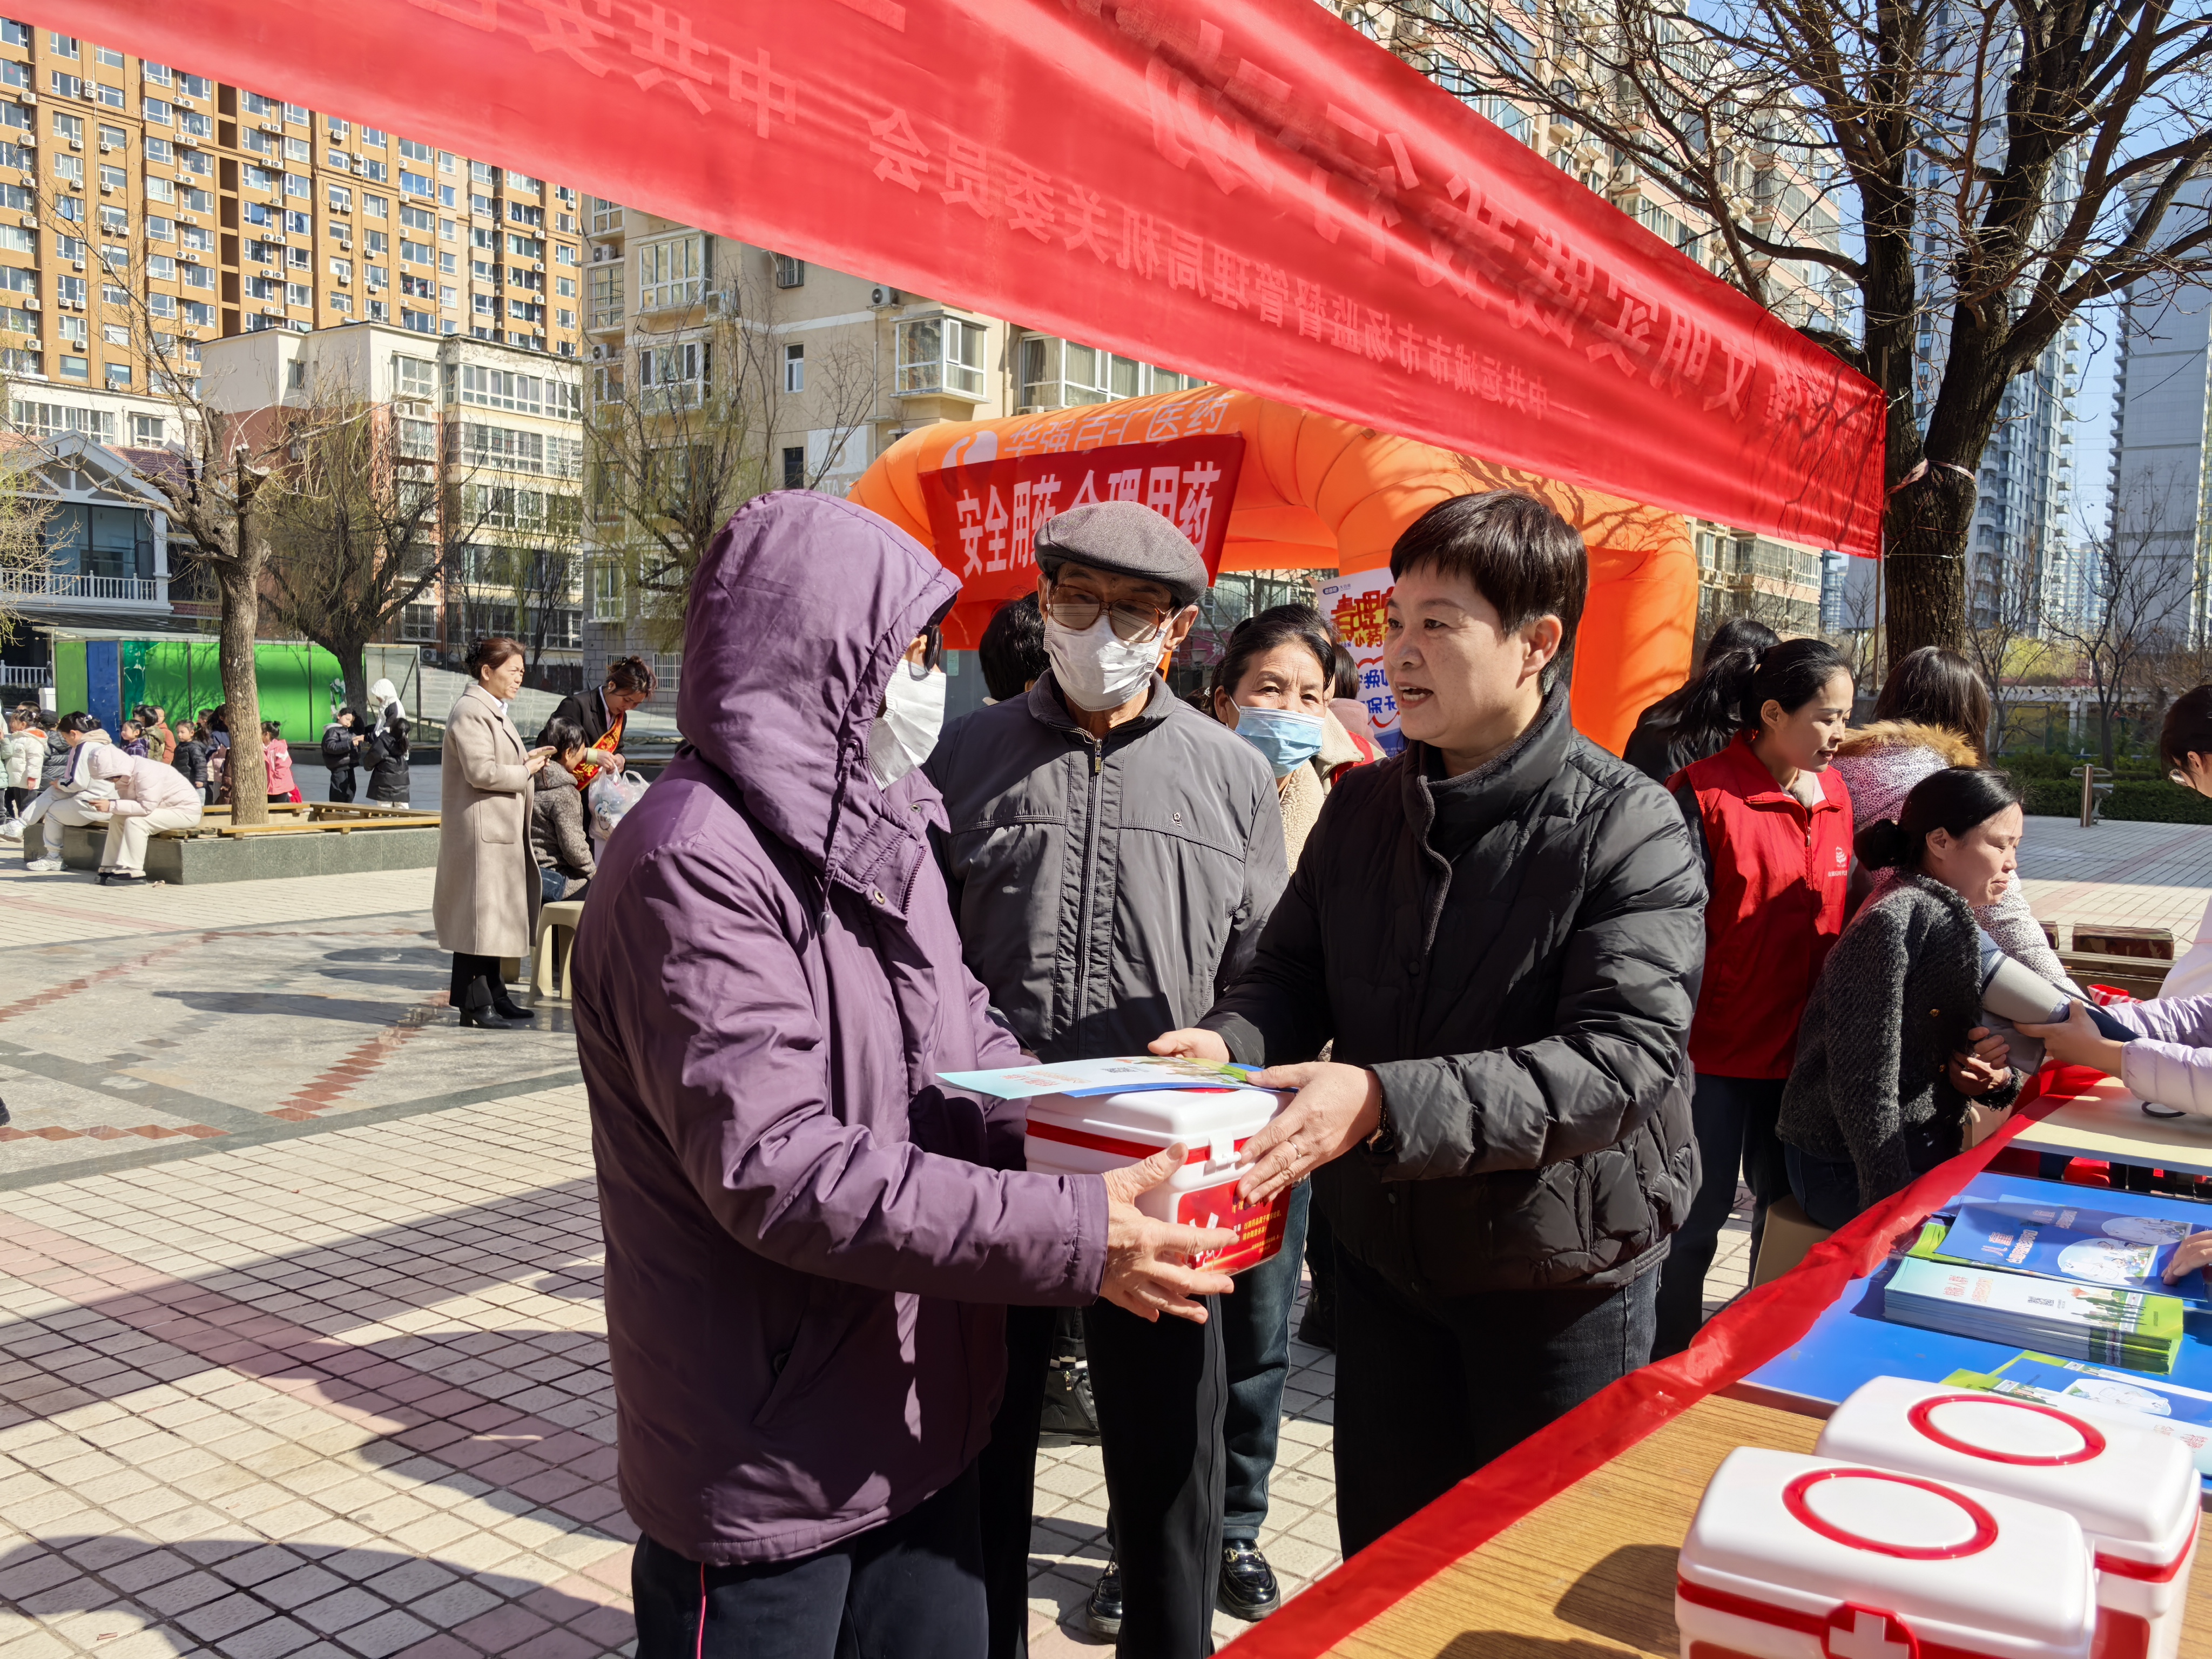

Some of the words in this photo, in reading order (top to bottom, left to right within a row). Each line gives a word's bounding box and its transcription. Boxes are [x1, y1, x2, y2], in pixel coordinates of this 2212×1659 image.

[828, 433, 846, 468] 5
[1004, 394, 1236, 457] 华强百汇医药
[956, 474, 1061, 578] 安全用药
